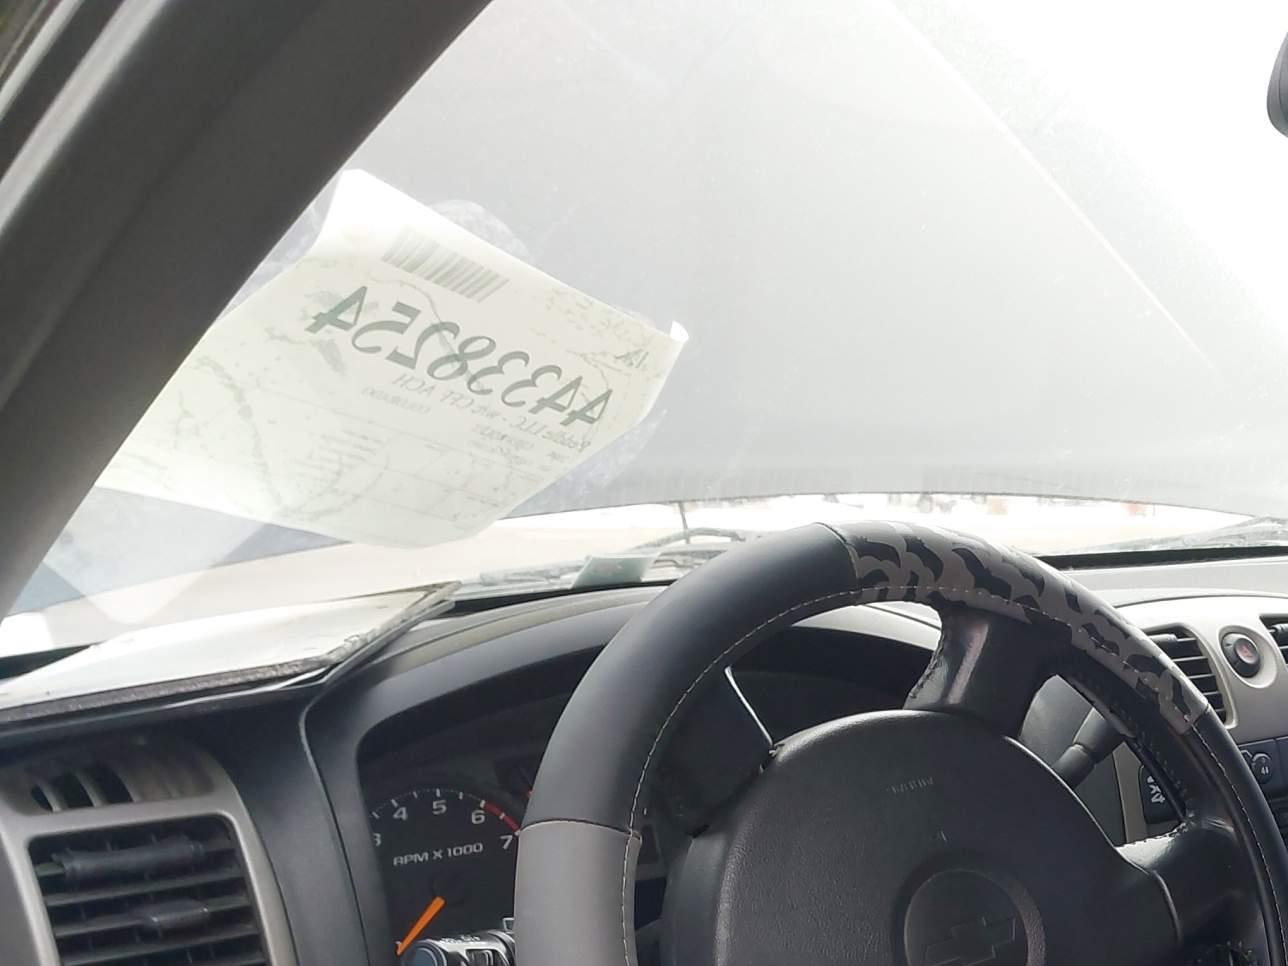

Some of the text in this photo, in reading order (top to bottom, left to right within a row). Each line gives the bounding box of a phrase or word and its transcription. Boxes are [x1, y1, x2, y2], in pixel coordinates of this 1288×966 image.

[393, 806, 408, 821] 4
[432, 799, 447, 815] 5
[471, 810, 485, 825] 6
[499, 834, 513, 850] 7
[392, 851, 429, 867] RPM
[446, 842, 484, 857] 1000
